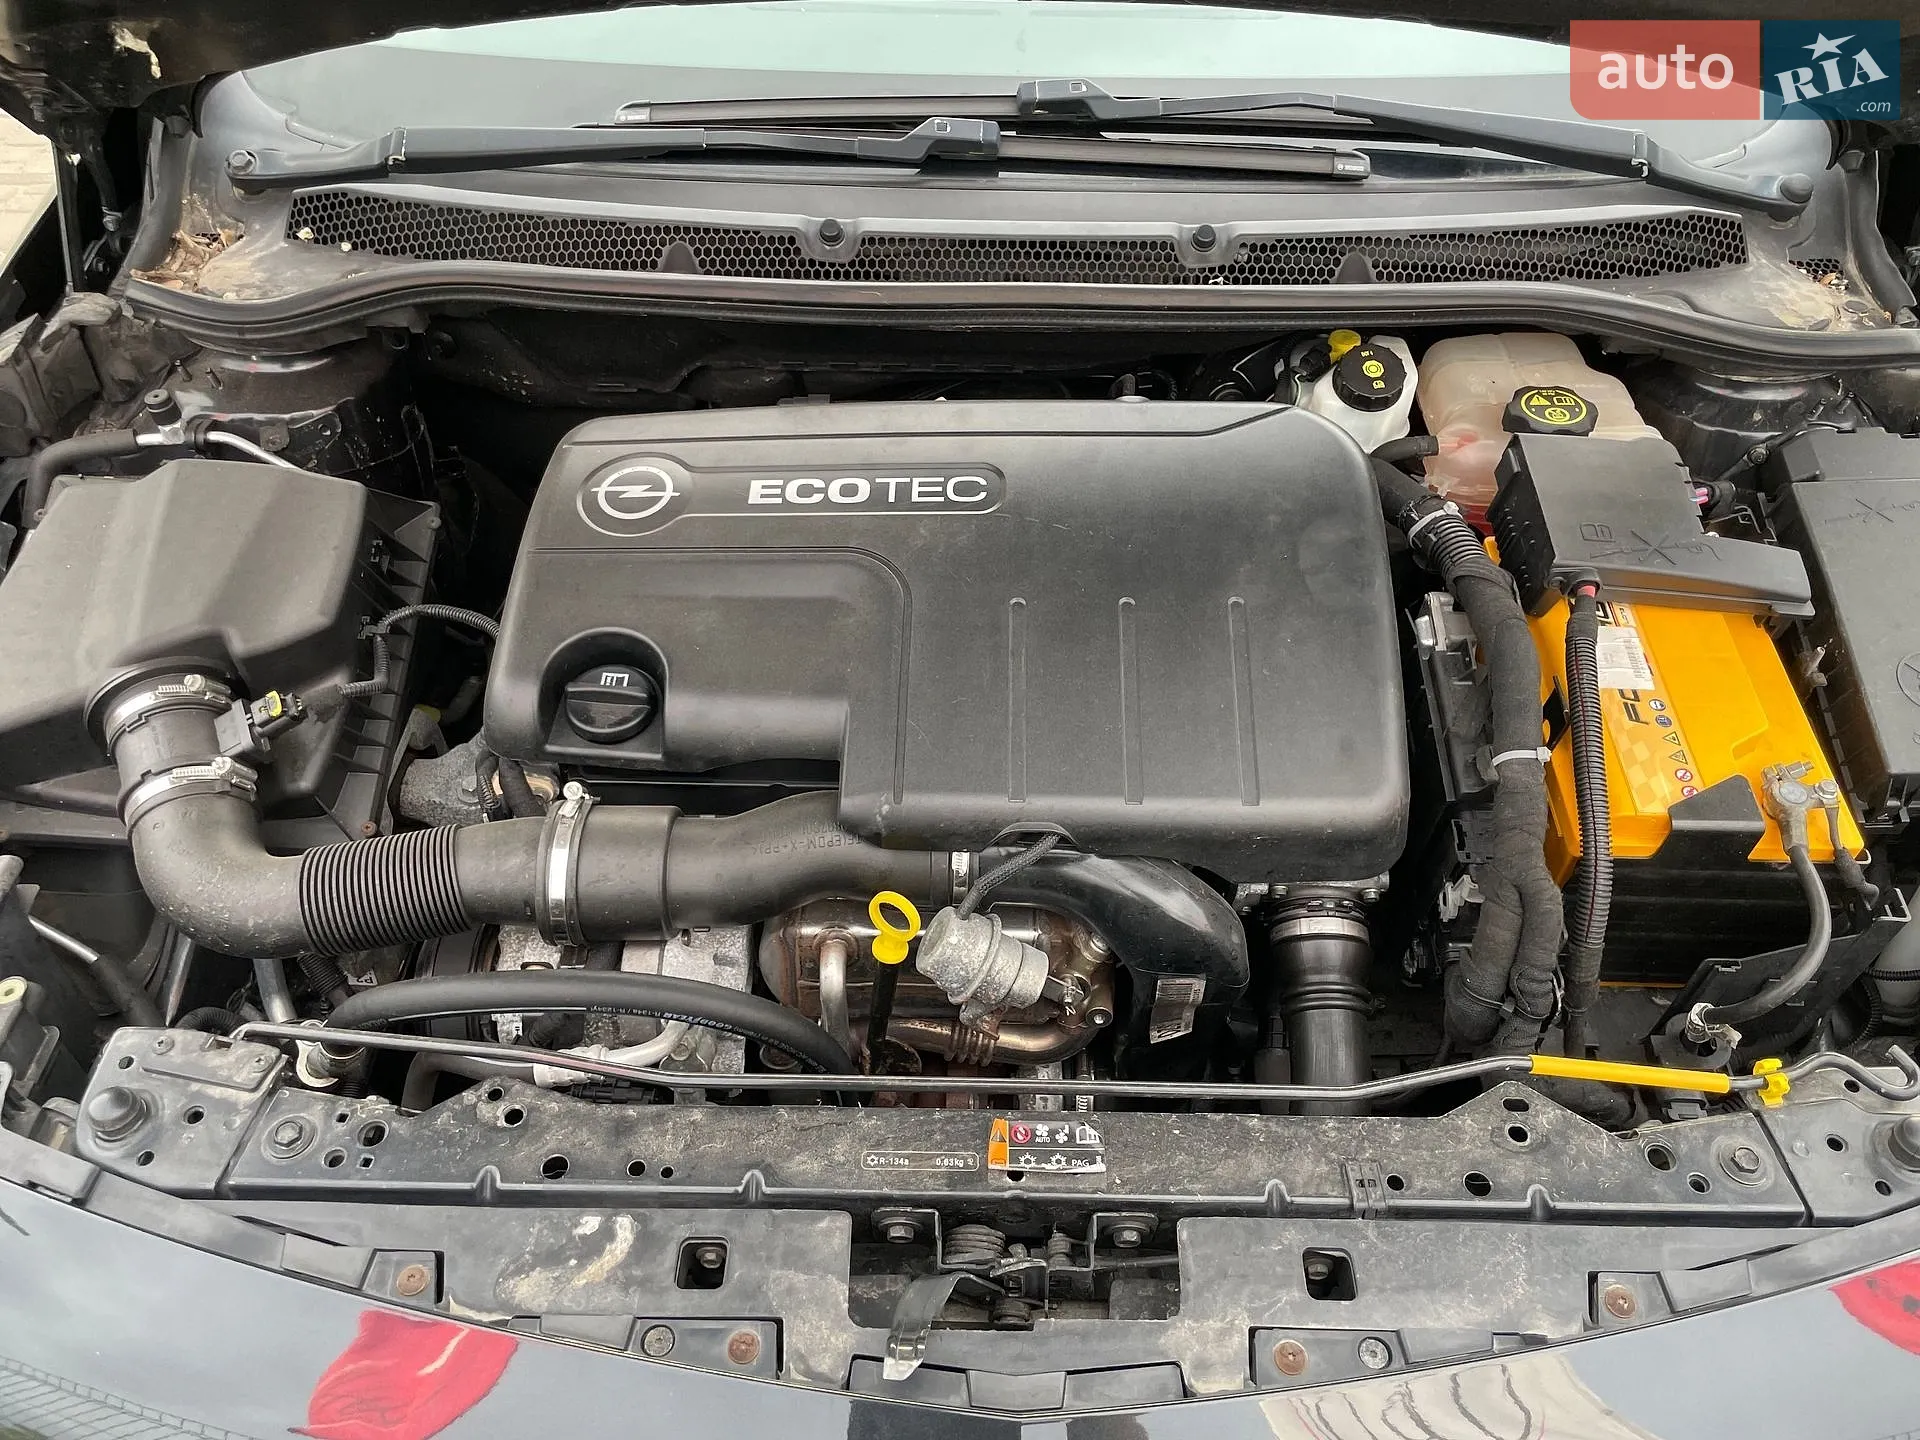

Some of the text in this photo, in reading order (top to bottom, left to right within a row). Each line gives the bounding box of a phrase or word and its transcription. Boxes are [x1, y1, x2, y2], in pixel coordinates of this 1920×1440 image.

[747, 476, 988, 504] ECOTEC
[879, 1157, 909, 1166] R-134a
[1071, 1159, 1090, 1167] PAG
